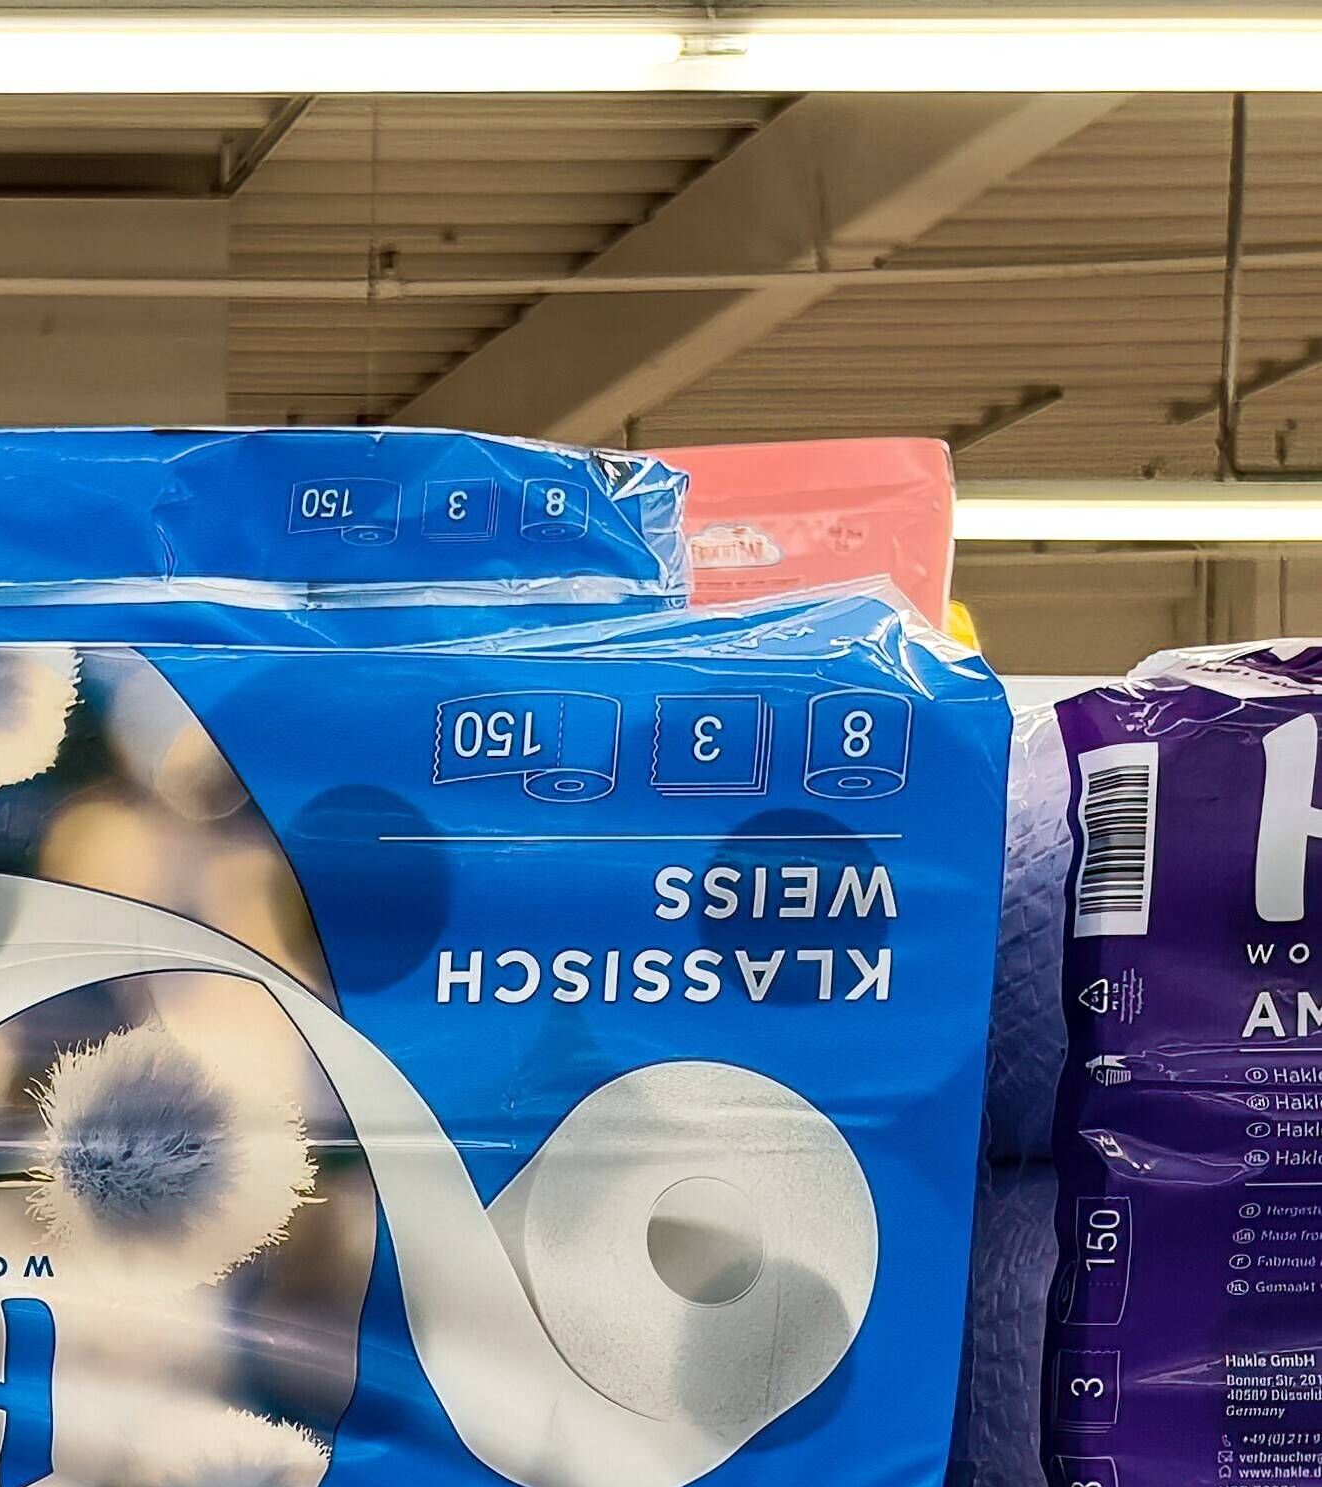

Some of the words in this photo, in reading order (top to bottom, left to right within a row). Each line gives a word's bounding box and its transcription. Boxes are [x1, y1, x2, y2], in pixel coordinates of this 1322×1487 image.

[301, 488, 353, 517] 150
[449, 489, 466, 519] 3
[546, 487, 565, 516] 8
[455, 711, 541, 757] 150
[693, 716, 722, 761] 3
[843, 711, 873, 757] 8
[655, 866, 897, 920] WEISS
[437, 949, 892, 1003] KLASSISCH
[1086, 1210, 1120, 1271] 150
[1071, 1378, 1104, 1397] 3
